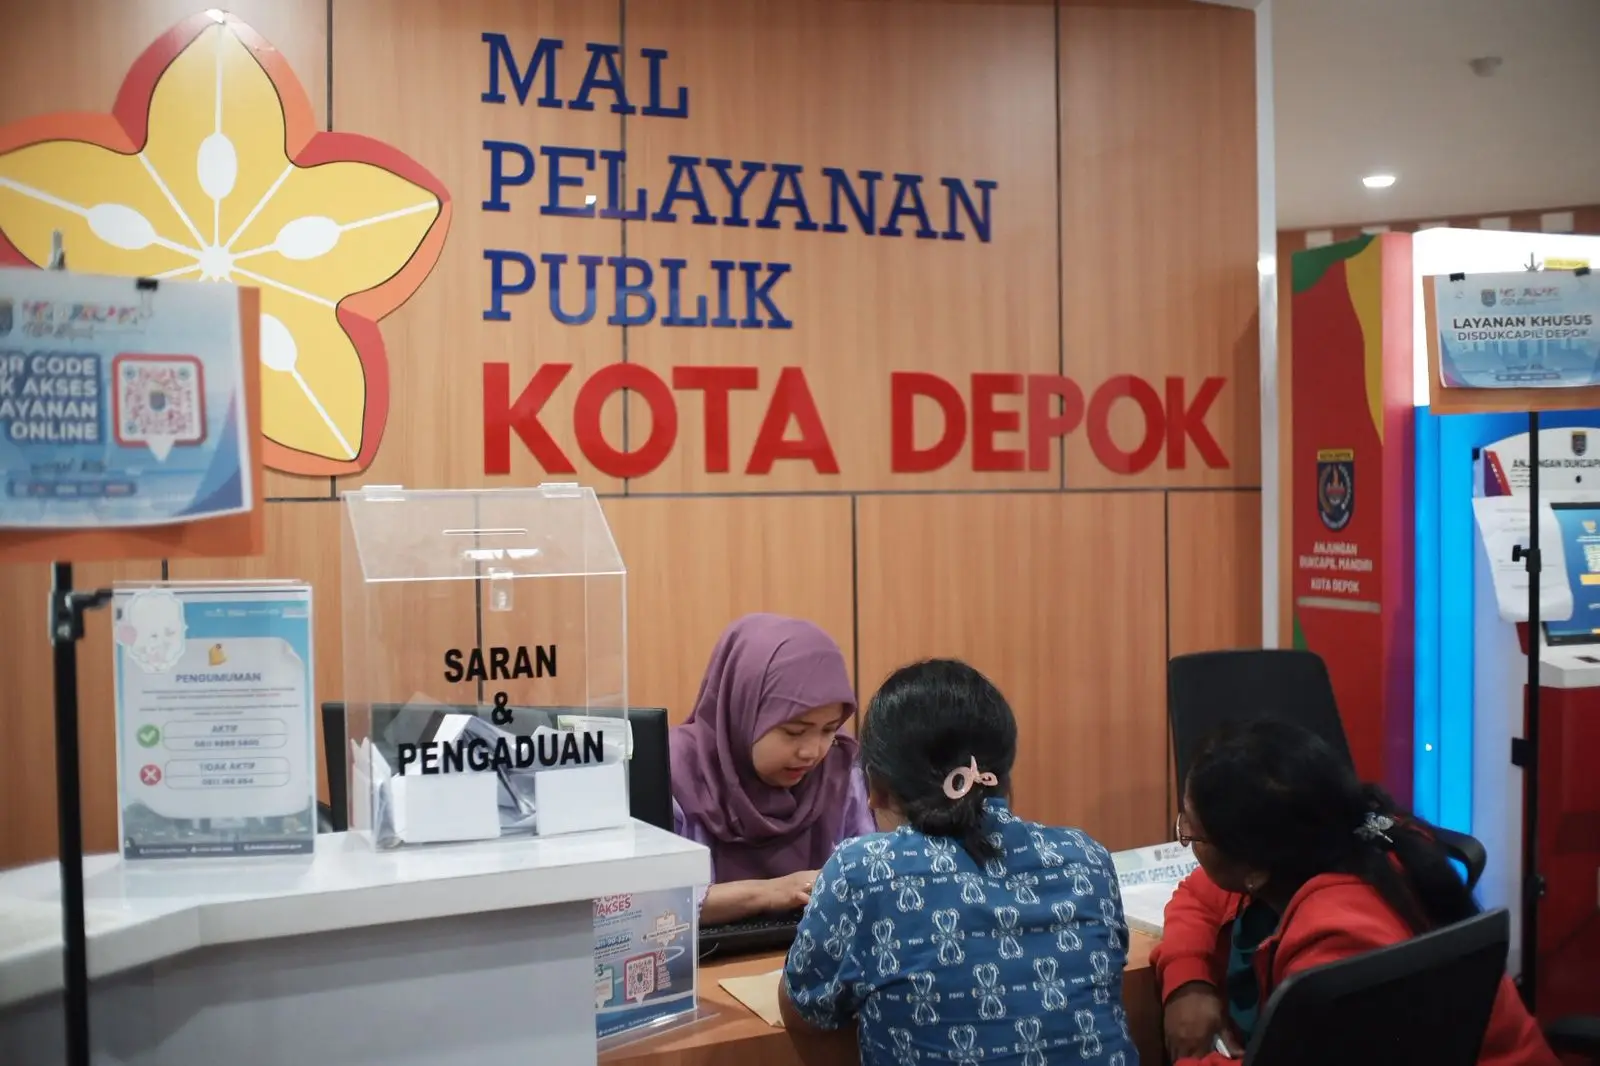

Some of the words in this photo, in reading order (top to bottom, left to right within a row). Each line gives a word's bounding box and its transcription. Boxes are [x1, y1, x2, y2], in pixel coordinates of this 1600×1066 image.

[481, 32, 689, 118] MAL
[481, 140, 998, 243] PELAYANAN
[482, 248, 793, 329] PUBLIK
[1453, 316, 1526, 329] LAYANAN
[1530, 314, 1593, 327] KHUSUS
[1457, 329, 1542, 341] DISDUKCAPIL
[1545, 328, 1590, 339] DEPOK
[31, 355, 98, 377] CODE
[22, 377, 98, 398] AKSES
[10, 420, 98, 441] ONLINE
[482, 362, 841, 479] KOTA
[889, 371, 1231, 475] DEPOK
[1311, 577, 1331, 591] KOTA
[1332, 579, 1360, 594] DEPOK
[444, 645, 557, 683] SARAN
[175, 672, 262, 683] PENGUMUMAN
[491, 692, 514, 725] &
[212, 725, 239, 733] AKTIF
[398, 731, 604, 776] PENGADUAN
